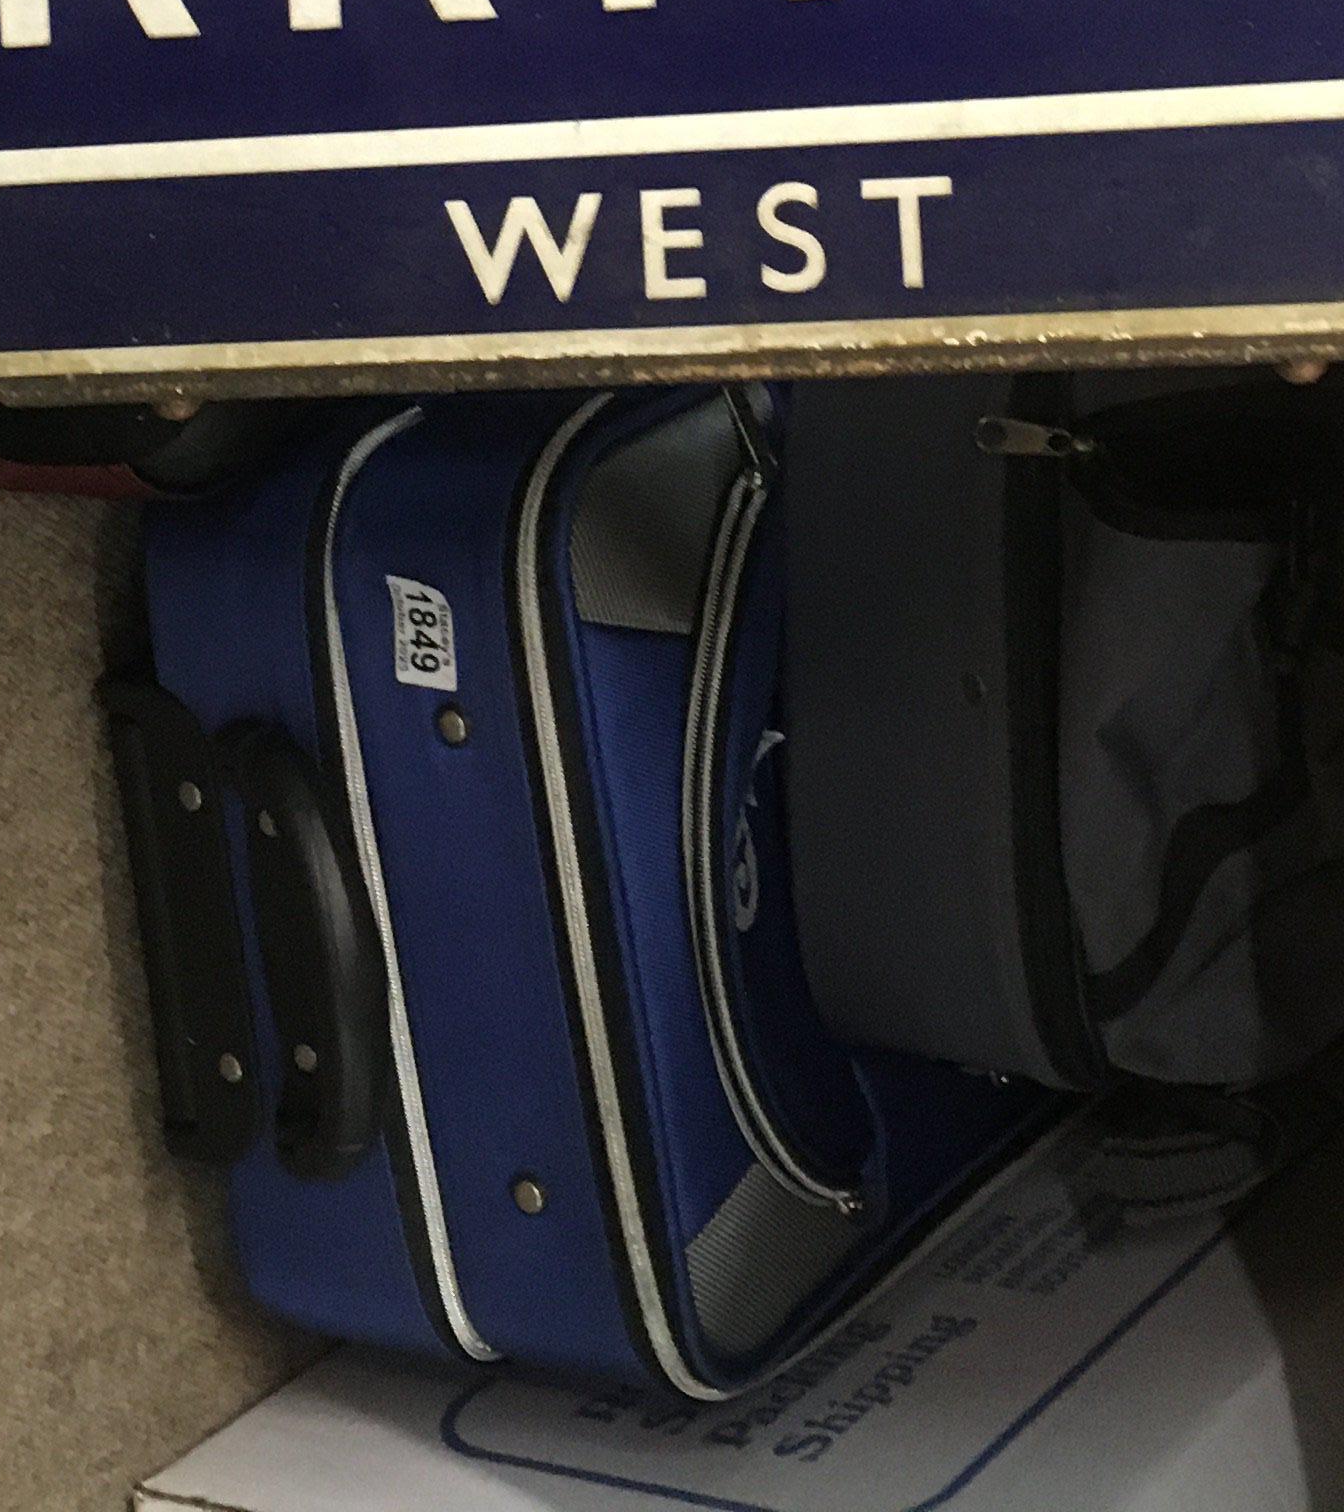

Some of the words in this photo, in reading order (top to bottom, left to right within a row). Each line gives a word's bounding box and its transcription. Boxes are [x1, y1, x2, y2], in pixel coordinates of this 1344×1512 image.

[446, 175, 954, 304] WEST
[406, 591, 441, 674] 1849
[772, 1313, 979, 1462] Shipping
